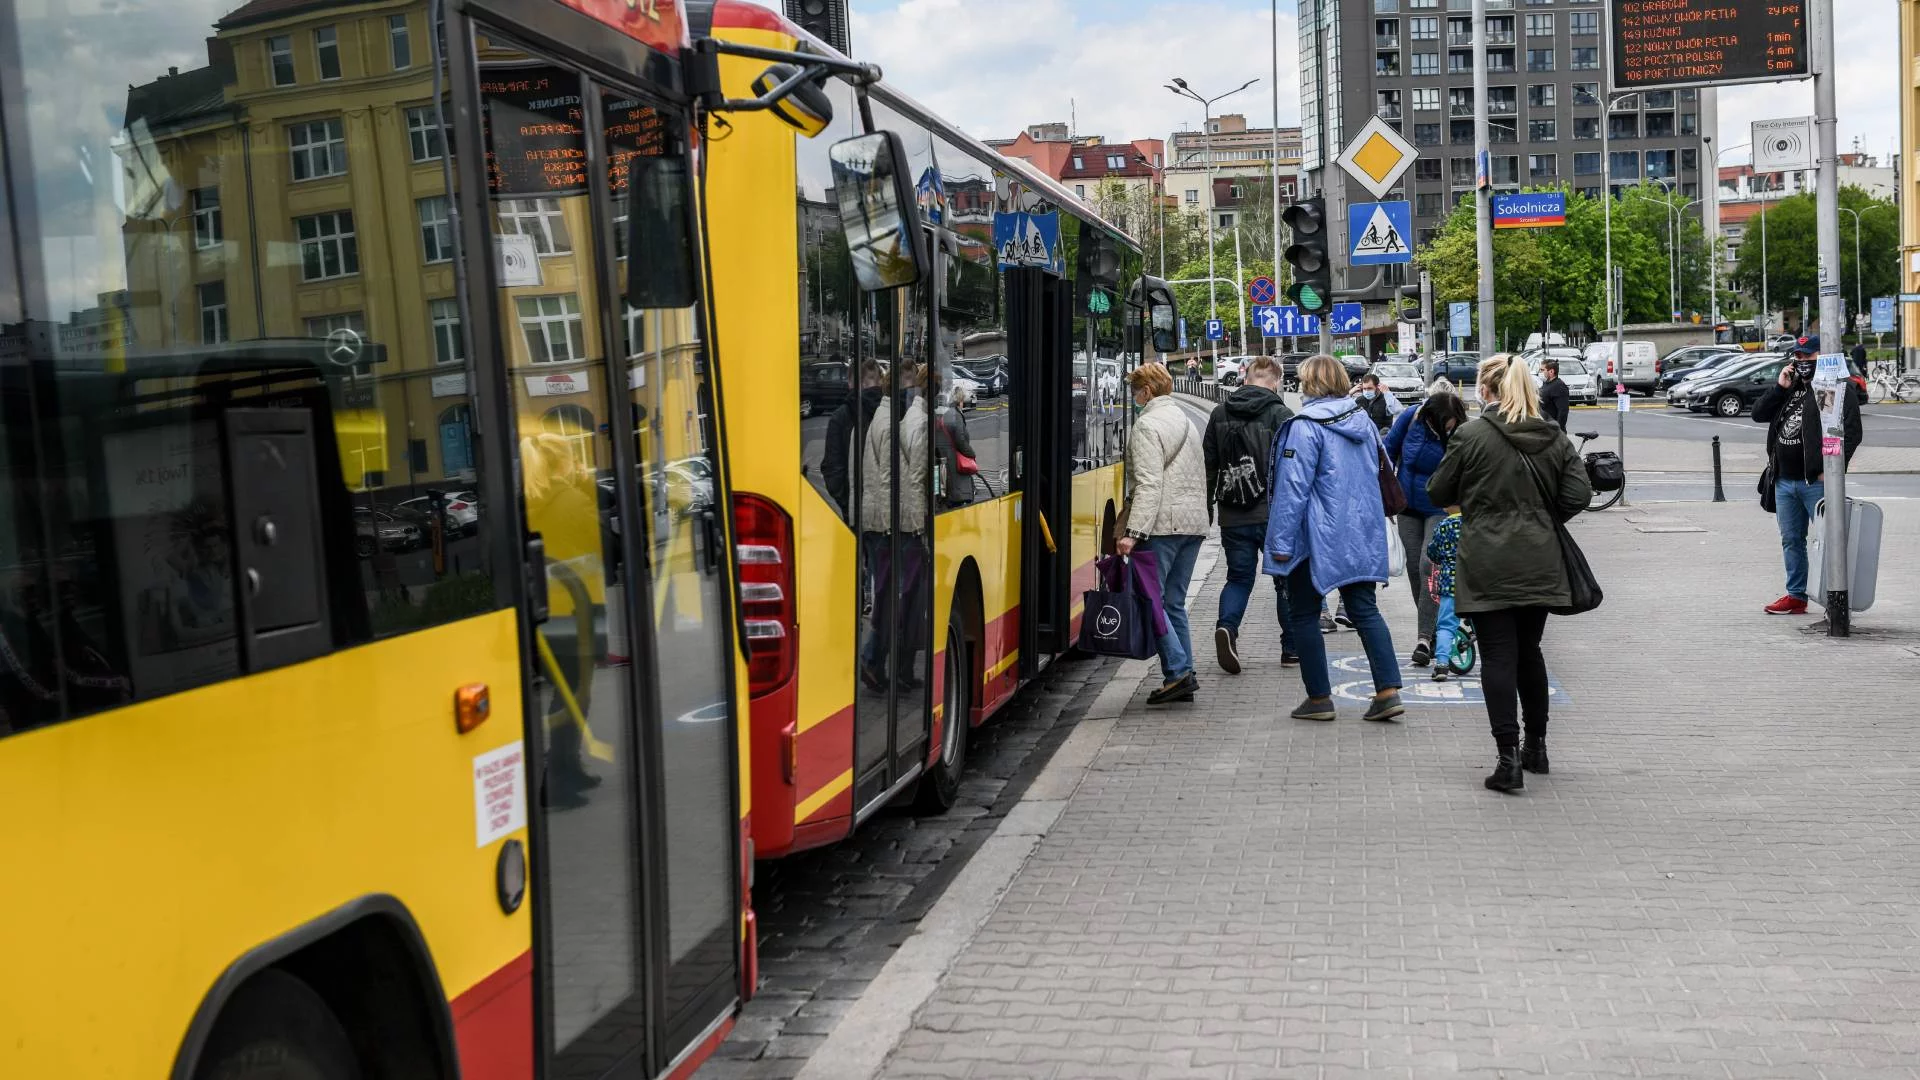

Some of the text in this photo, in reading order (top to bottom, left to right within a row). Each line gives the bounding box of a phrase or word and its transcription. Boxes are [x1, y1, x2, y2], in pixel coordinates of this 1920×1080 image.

[1622, 2, 1640, 12] 102
[1622, 17, 1640, 26] 142
[1643, 13, 1672, 25] NOWY
[1622, 30, 1640, 40] 149
[1624, 44, 1641, 54] 122
[1644, 40, 1672, 52] NOWY
[1775, 32, 1790, 42] min
[1644, 54, 1683, 66] POCZTA
[1686, 51, 1723, 62] POLSKA
[1767, 46, 1774, 55] 4
[1778, 45, 1794, 55] min
[1625, 59, 1792, 81] 106 PORT LOTNICZY 5 min
[1498, 202, 1560, 215] Sokolnicza
